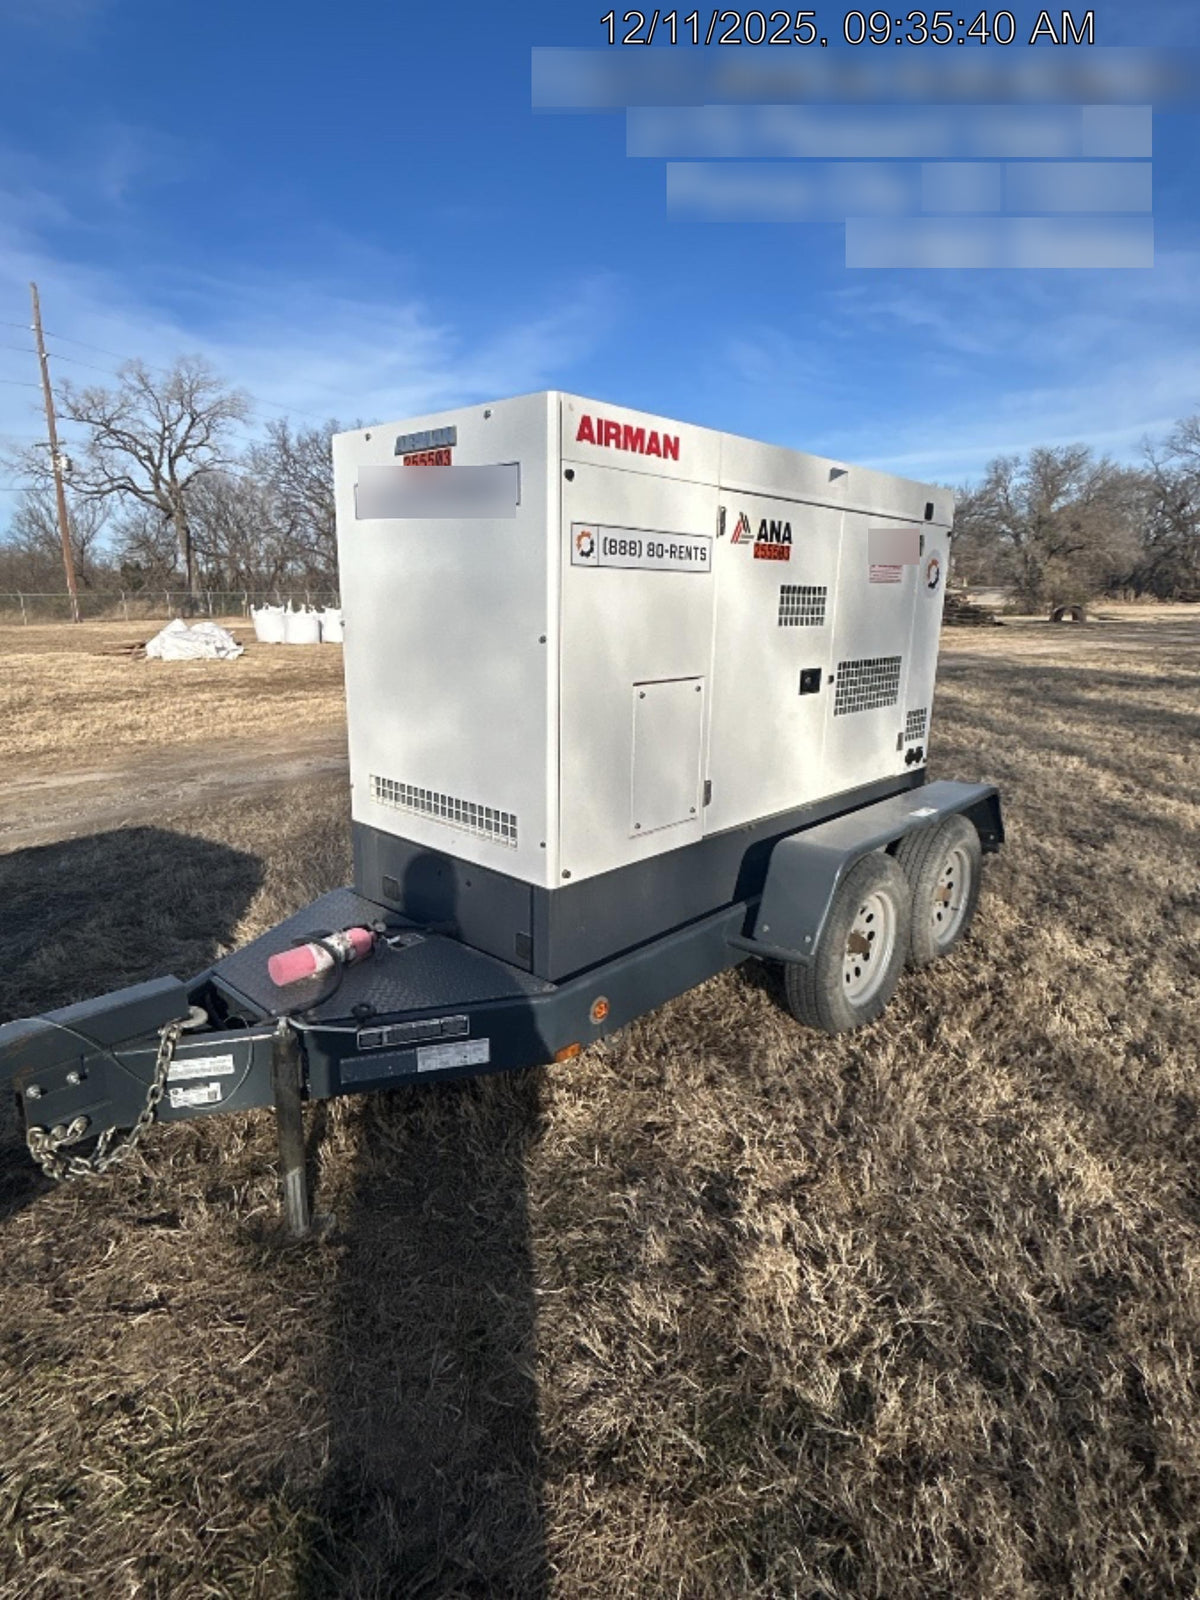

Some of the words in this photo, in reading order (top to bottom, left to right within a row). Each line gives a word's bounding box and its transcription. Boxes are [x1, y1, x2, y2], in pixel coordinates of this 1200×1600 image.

[576, 415, 680, 461] AIRMAN
[757, 519, 792, 544] ANA
[603, 537, 642, 558] (888)
[646, 542, 707, 561] 80-RENTS
